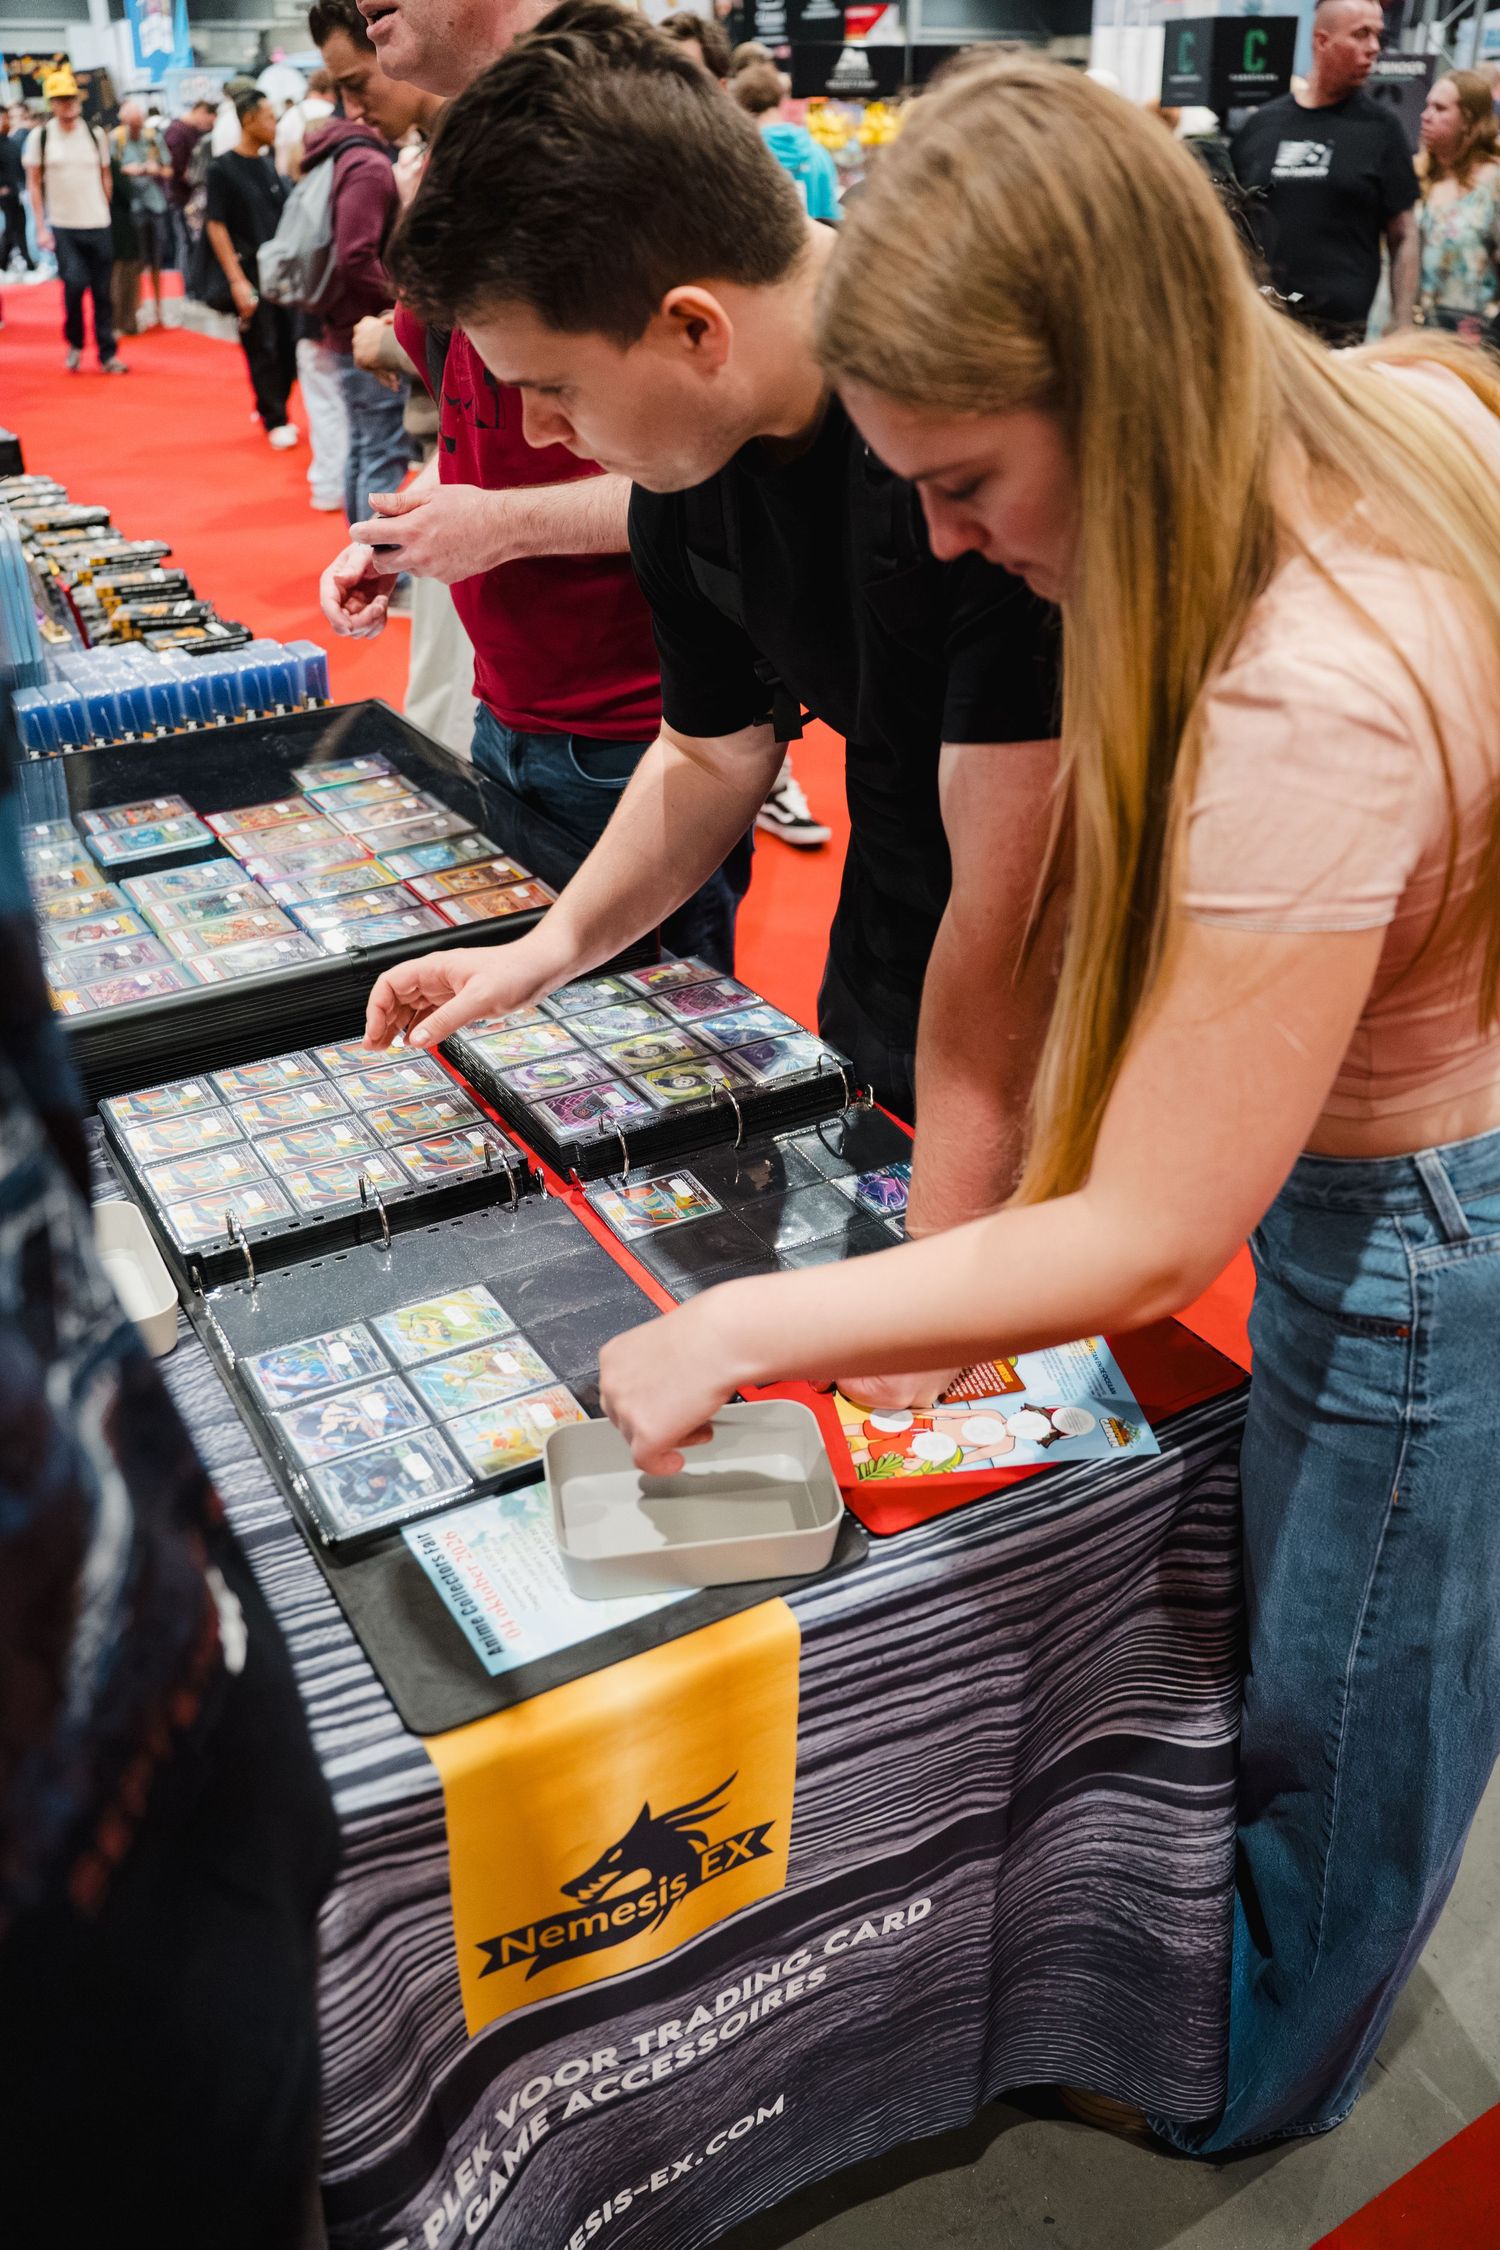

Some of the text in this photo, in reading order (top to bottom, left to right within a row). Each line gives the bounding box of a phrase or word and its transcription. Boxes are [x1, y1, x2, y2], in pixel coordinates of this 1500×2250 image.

[1242, 28, 1268, 73] C
[417, 1532, 505, 1656] Anime Collectors Fair
[442, 1530, 522, 1639] 04 oktober 2026
[500, 1830, 756, 1965] Nemesis EX
[422, 1898, 932, 2250] PLEK VOOR TRADING CARD
[465, 1965, 827, 2236] GAME ACCESSOIRES
[564, 2094, 785, 2250] ESIS-EX.COM
